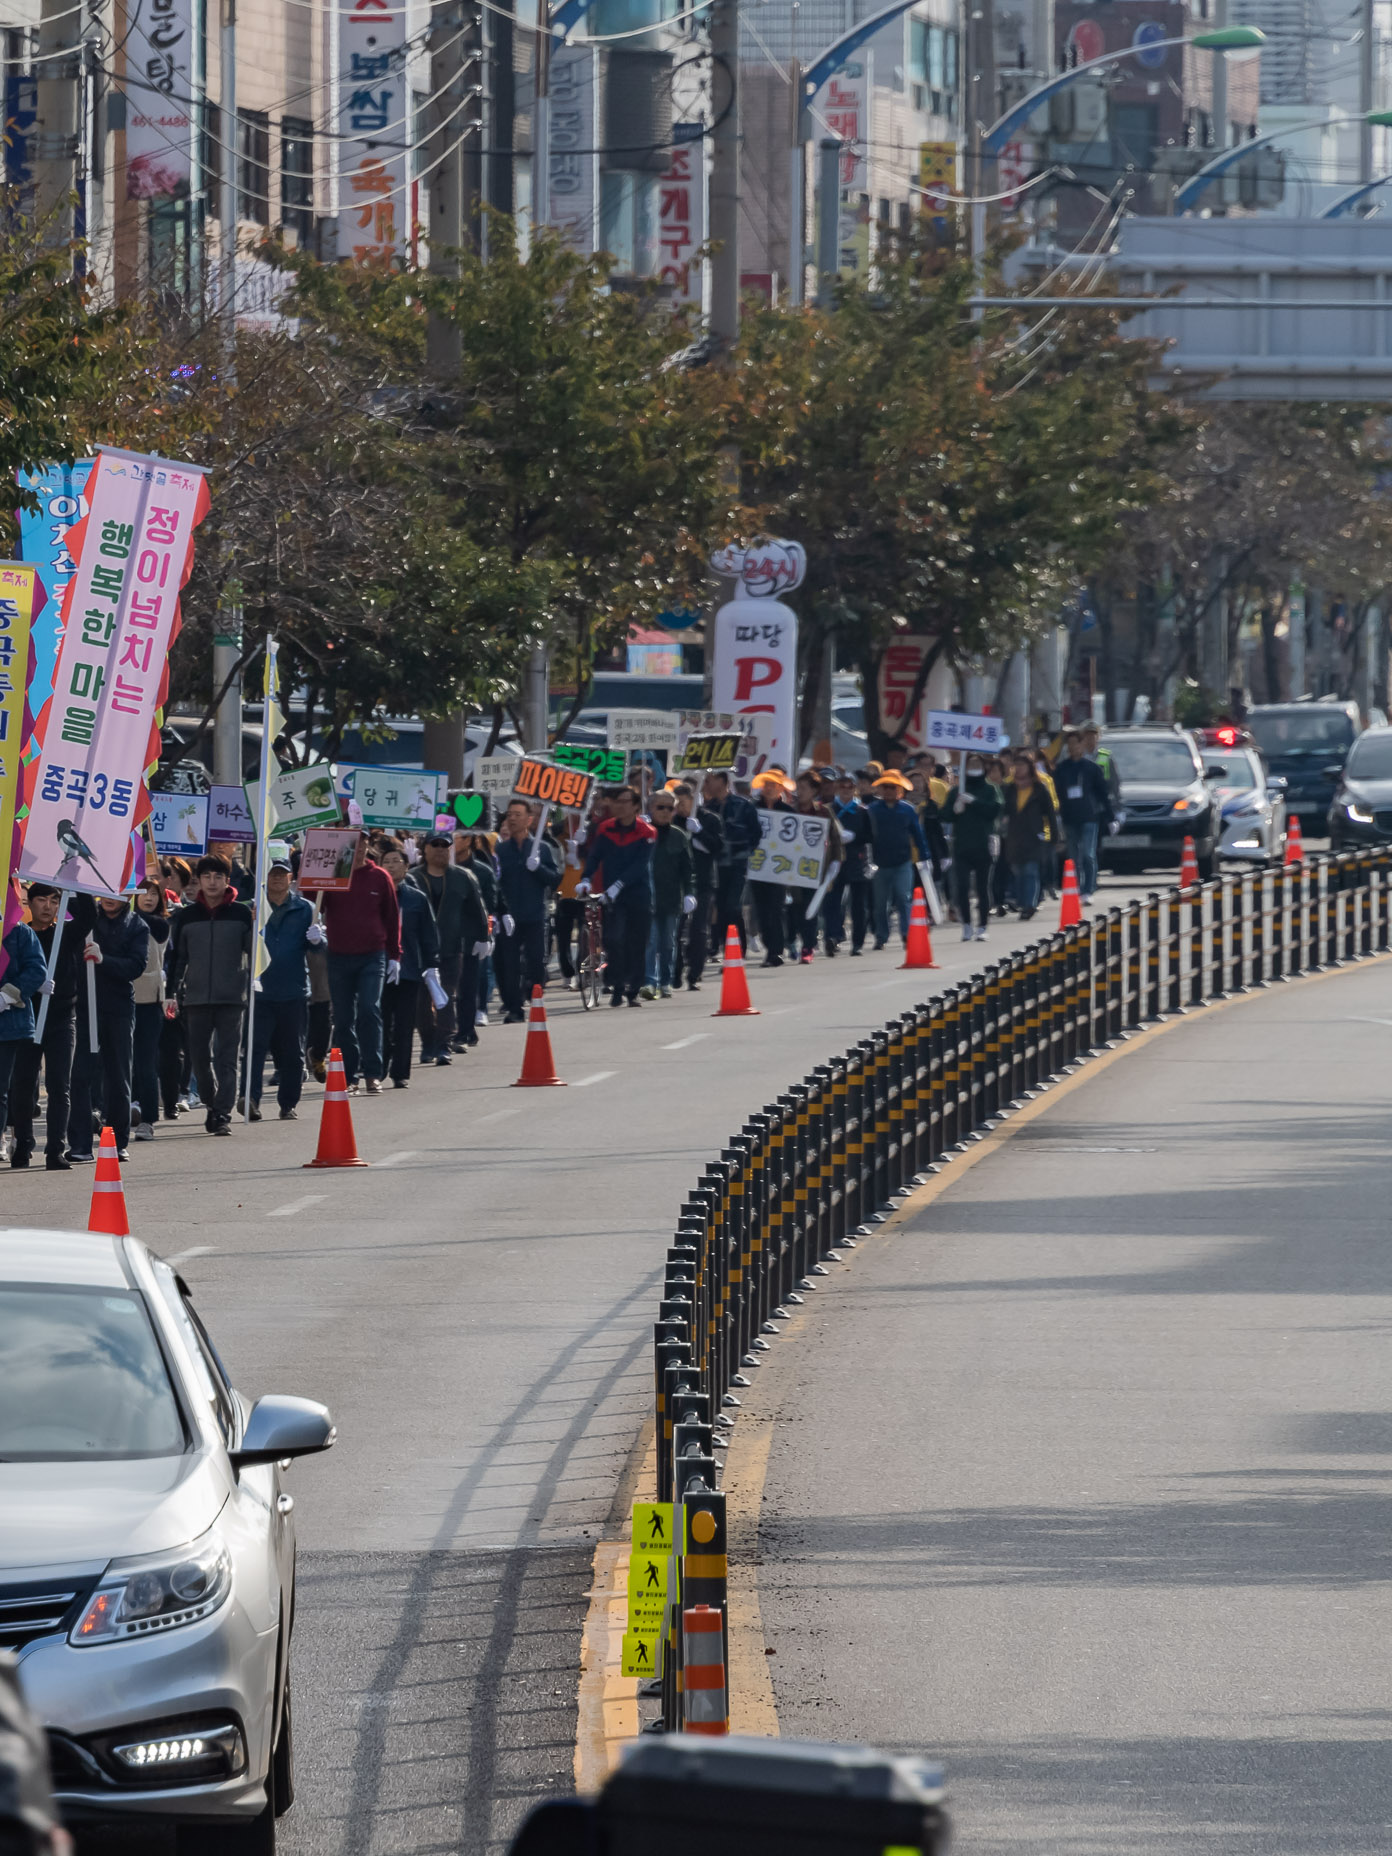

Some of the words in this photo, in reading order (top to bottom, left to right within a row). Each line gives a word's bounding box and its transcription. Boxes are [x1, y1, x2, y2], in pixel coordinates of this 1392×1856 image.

[348, 53, 393, 130] 보쌈
[169, 473, 195, 491] 축제
[1, 570, 28, 588] 축제
[733, 656, 784, 713] P
[931, 720, 998, 744] 중곡제4동
[41, 763, 134, 818] 중곡3동
[513, 759, 589, 808] 파이팅!
